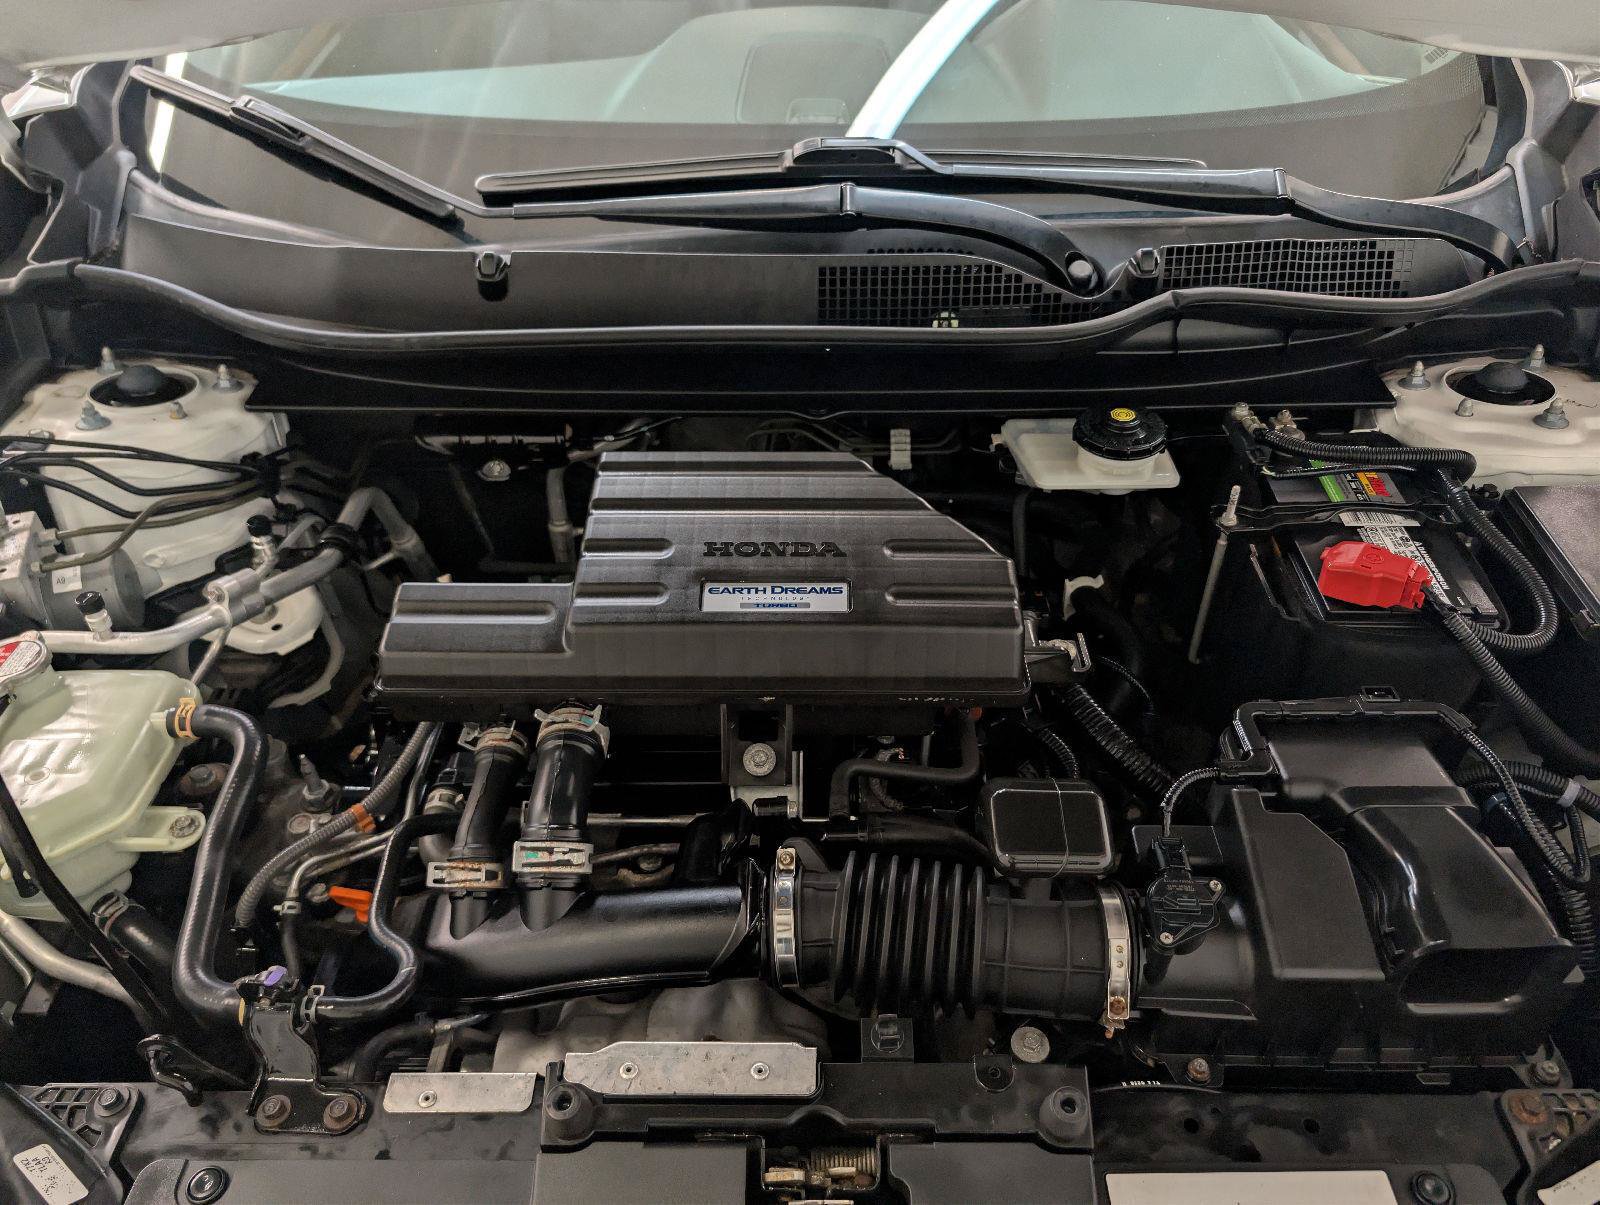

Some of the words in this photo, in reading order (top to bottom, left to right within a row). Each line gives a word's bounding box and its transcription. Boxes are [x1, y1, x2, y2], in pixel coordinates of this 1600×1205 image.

[703, 541, 847, 558] HONDA
[708, 586, 767, 595] EARTH
[771, 585, 843, 595] DREAMS
